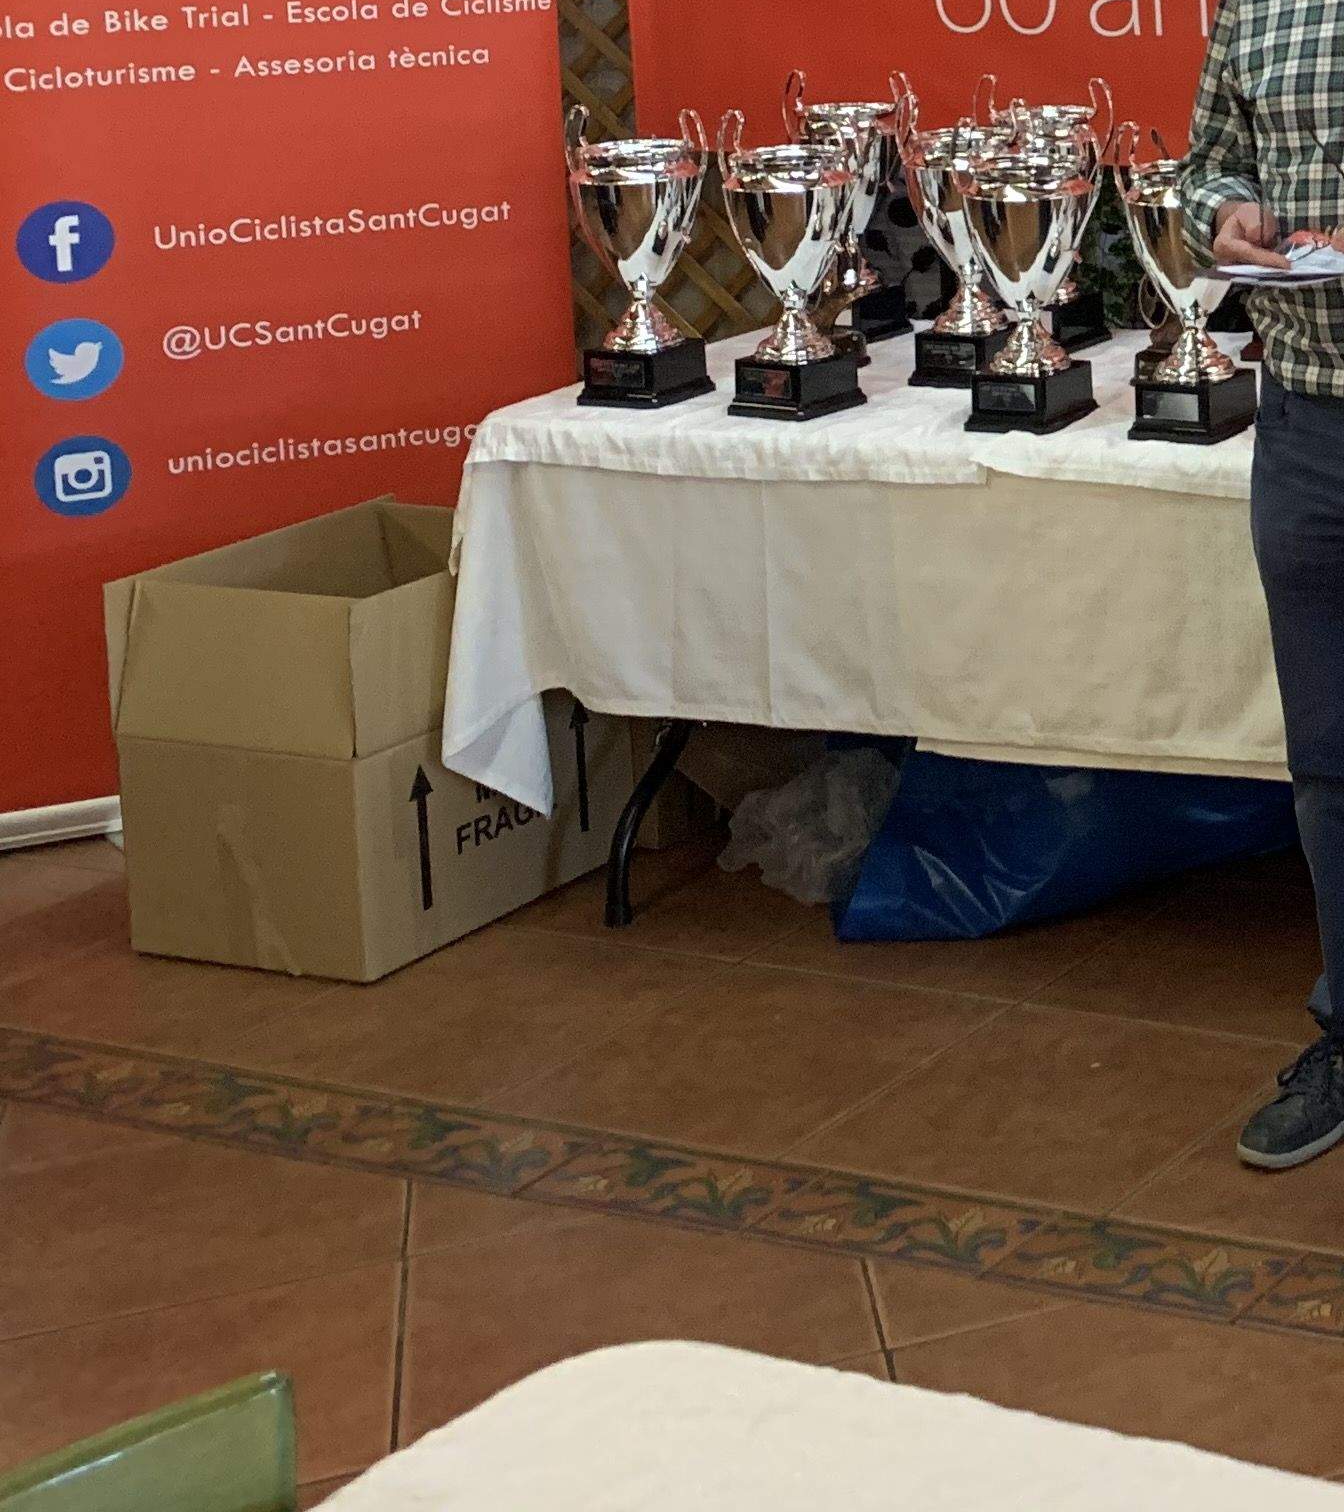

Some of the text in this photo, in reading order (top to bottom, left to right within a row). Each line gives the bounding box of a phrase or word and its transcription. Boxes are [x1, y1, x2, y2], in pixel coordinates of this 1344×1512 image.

[49, 12, 90, 37] de
[104, 8, 169, 33] Bike
[180, 3, 249, 29] Trial
[3, 62, 196, 92] Cicloturisme
[234, 49, 376, 78] Assesoria
[387, 44, 490, 69] tècnica
[153, 201, 511, 250] UnioCiclistaSantCugat
[162, 310, 422, 360] @UCSantCugat
